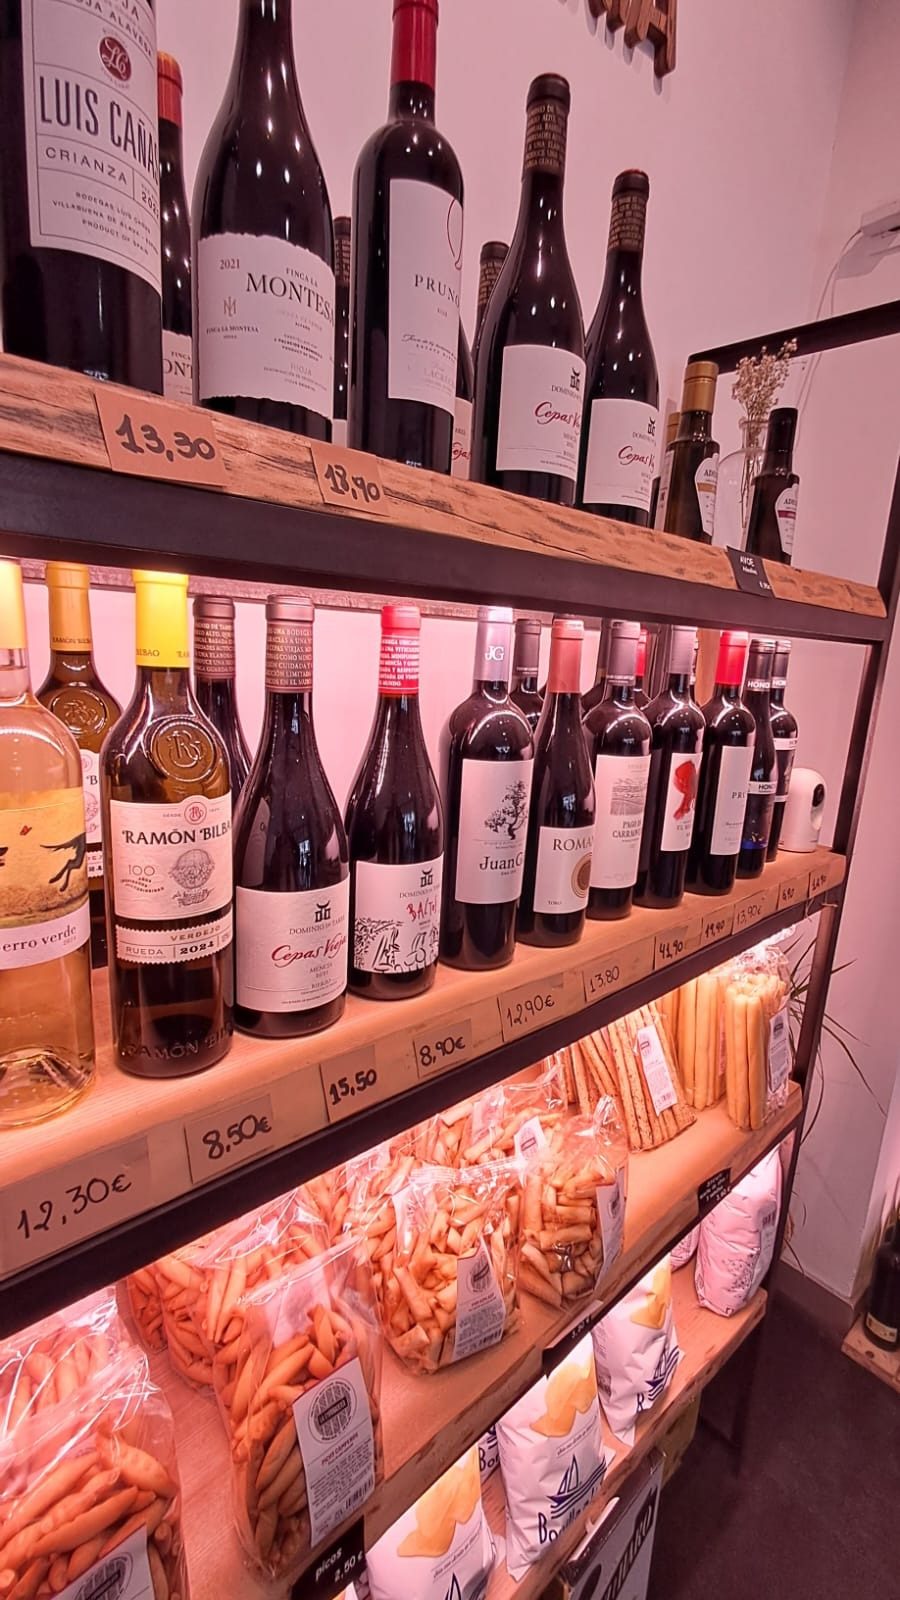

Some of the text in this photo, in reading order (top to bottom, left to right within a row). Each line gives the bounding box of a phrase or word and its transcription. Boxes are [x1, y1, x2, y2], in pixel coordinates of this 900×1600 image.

[39, 75, 99, 136] LUIS
[45, 146, 127, 185] CRIANZA
[75, 191, 114, 210] BODEGAS
[82, 218, 119, 237] PRODUCT
[219, 258, 240, 271] 2021
[286, 267, 309, 283] FINCA
[115, 413, 216, 463] 13,30
[122, 828, 197, 845] RAMÓN
[553, 835, 594, 851] ROMA
[128, 864, 155, 876] 100
[0, 937, 37, 953] erro
[41, 924, 77, 944] verde
[170, 924, 221, 942] VERDEJO
[126, 940, 215, 955] RUEDA 2021
[271, 944, 324, 969] Cepas
[420, 1036, 466, 1067] 8,90€
[329, 1068, 378, 1106] 15,50
[203, 1113, 273, 1160] 8,50€
[17, 1173, 132, 1240] 12,30€
